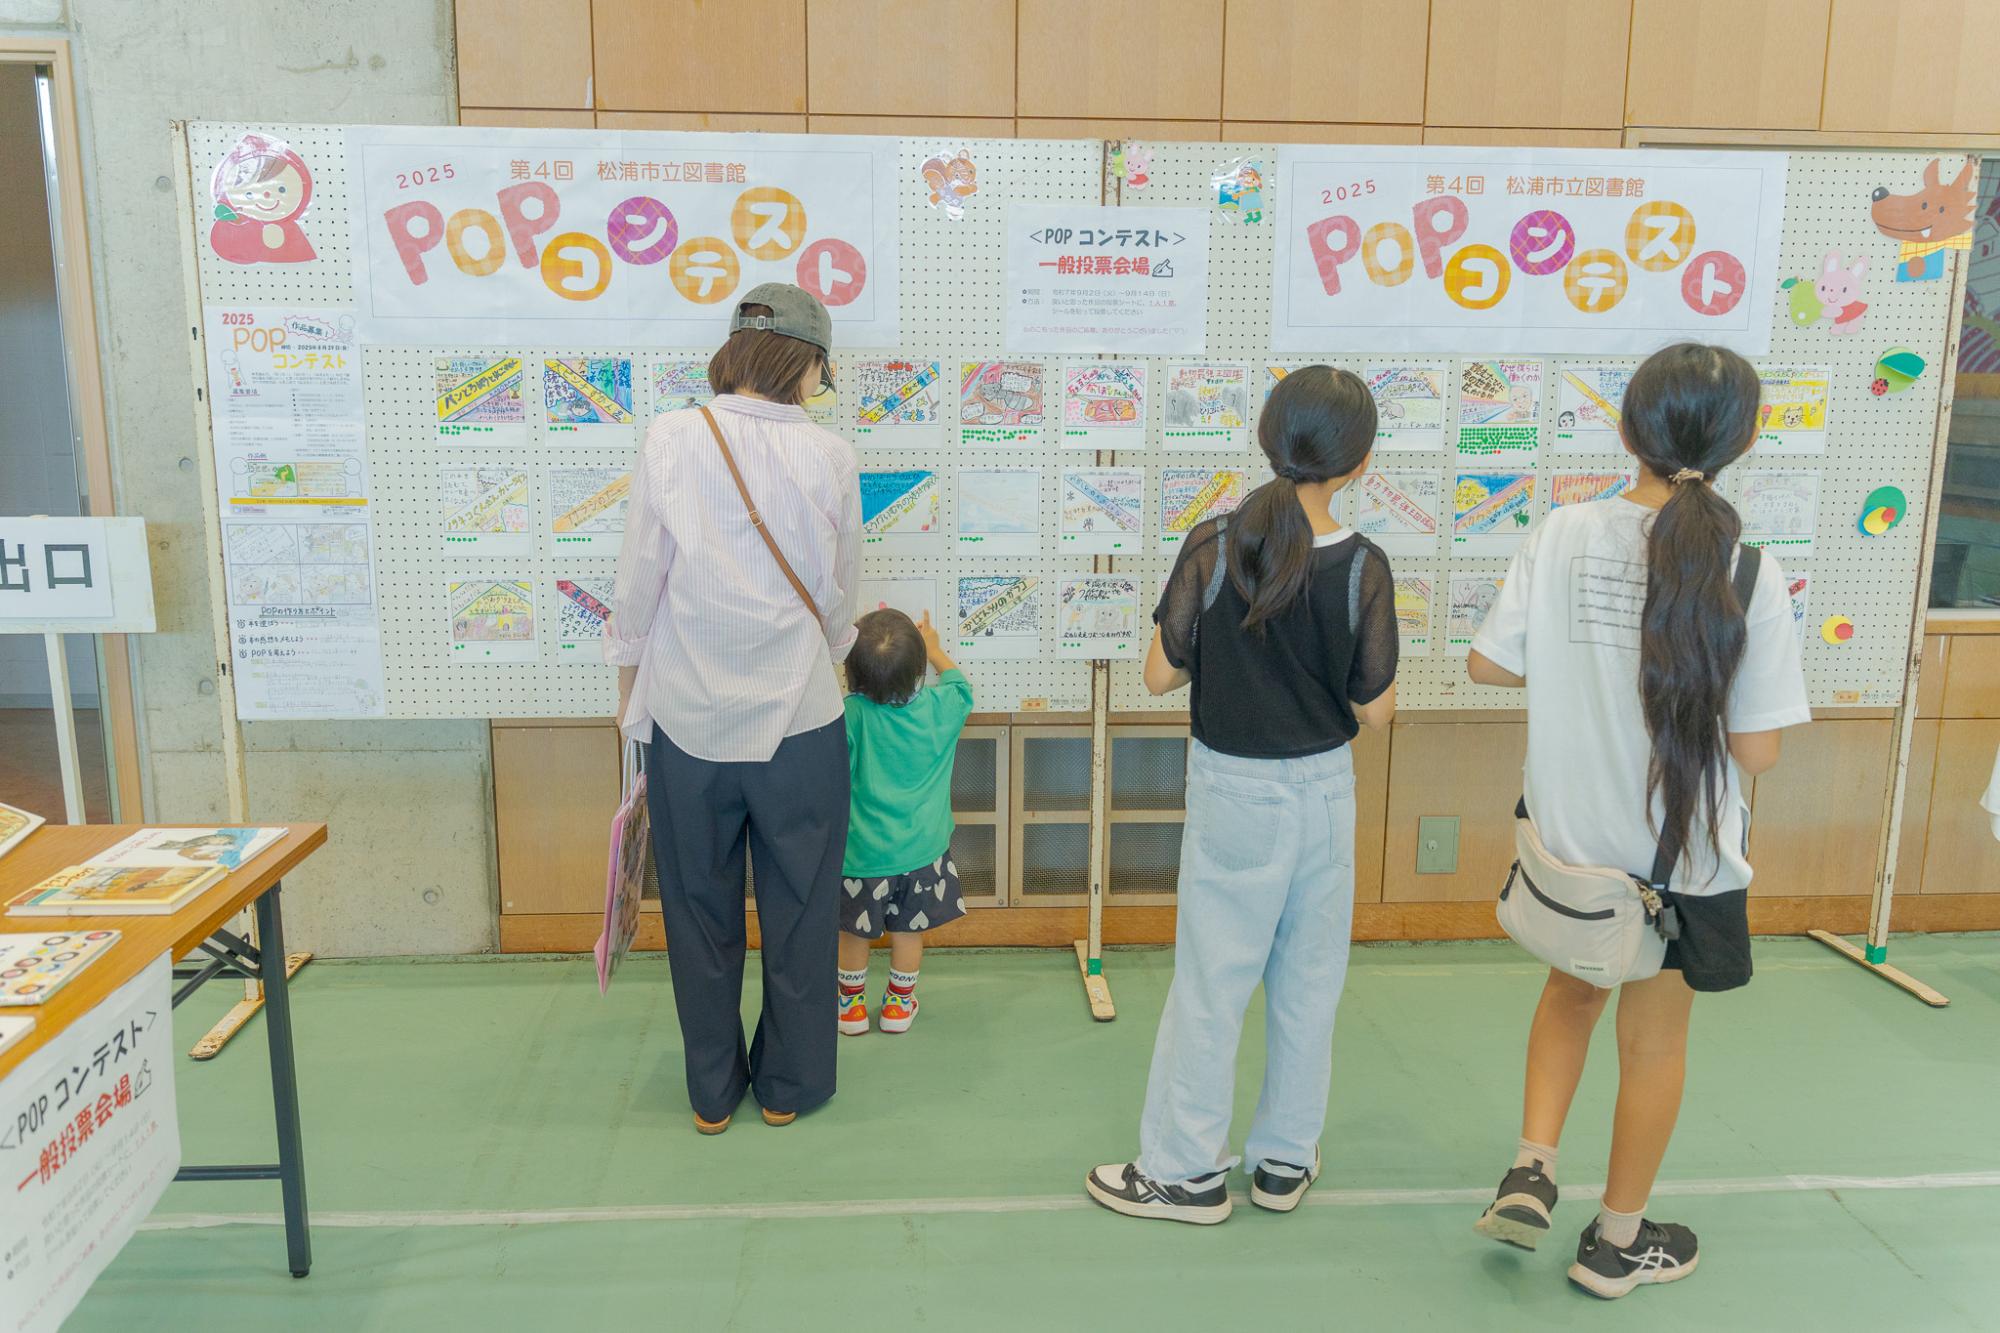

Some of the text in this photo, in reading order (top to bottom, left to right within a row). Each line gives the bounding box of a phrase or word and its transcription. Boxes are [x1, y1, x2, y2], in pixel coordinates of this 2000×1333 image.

[396, 163, 456, 190] 2025
[510, 159, 747, 184] 第4回 松浦市立図書館
[1321, 178, 1377, 205] 2025
[1425, 174, 1645, 199] 第4回 松浦市立図書館
[1038, 255, 1150, 276] 一般投票会場
[222, 313, 255, 325] 2025
[233, 327, 286, 353] POP
[272, 353, 347, 370] コンテスト
[17, 1072, 134, 1192] 一般投票会場
